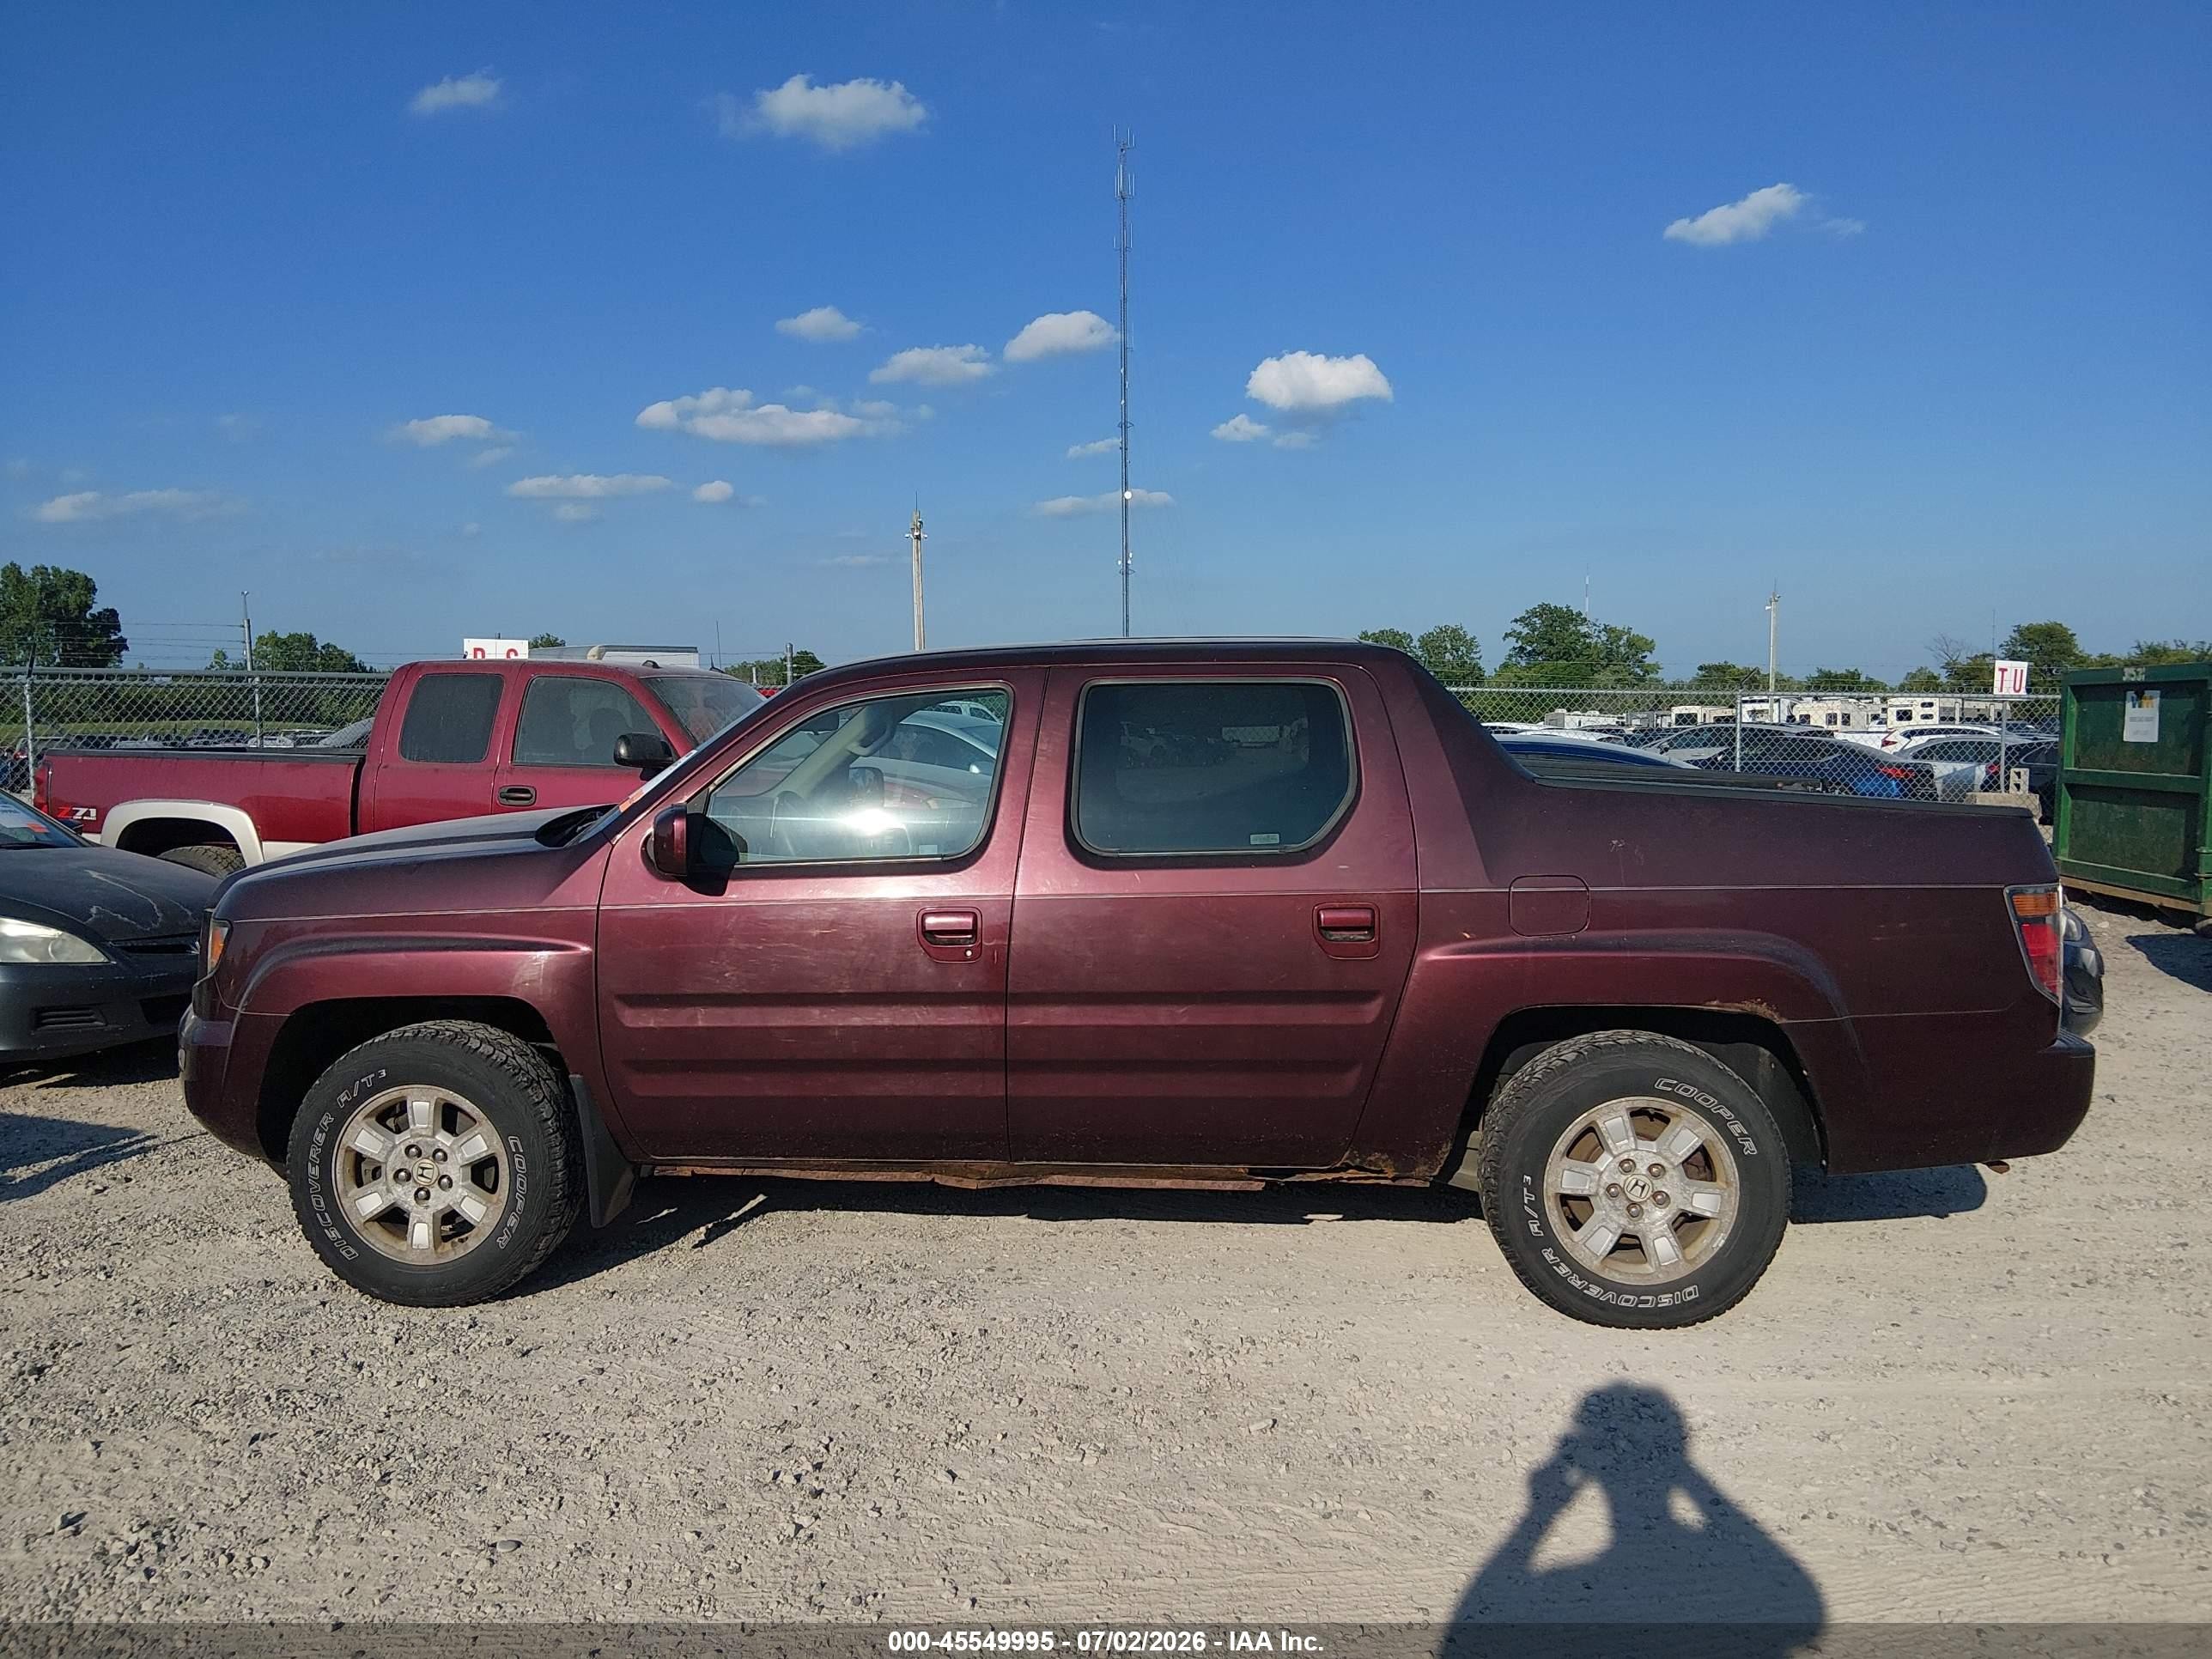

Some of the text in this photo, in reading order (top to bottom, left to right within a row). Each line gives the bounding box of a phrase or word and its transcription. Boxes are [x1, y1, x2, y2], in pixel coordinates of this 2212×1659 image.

[57, 807, 97, 818] Z71
[1653, 1077, 1758, 1156] COOPER
[301, 1111, 359, 1261] DISCOVERER
[495, 1135, 528, 1249] COOPER
[1540, 1248, 1700, 1308] DISCOVERER
